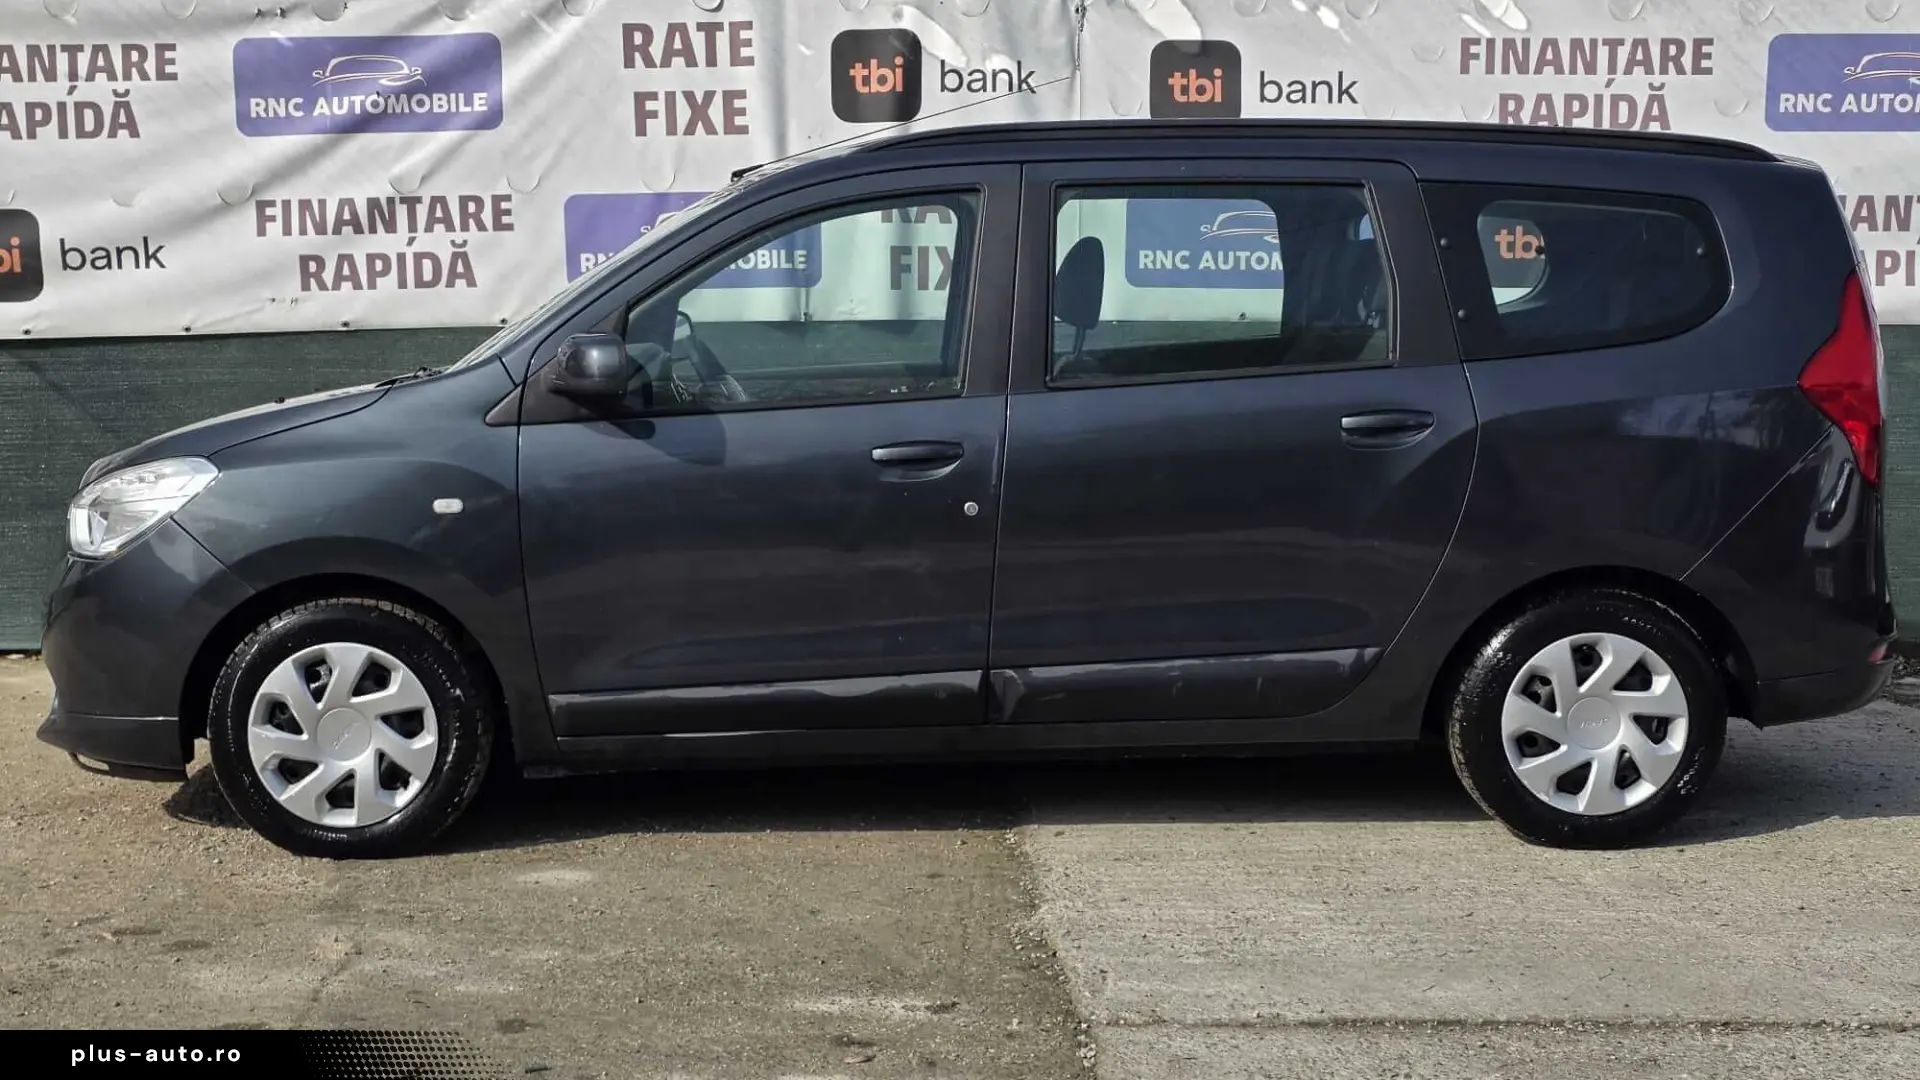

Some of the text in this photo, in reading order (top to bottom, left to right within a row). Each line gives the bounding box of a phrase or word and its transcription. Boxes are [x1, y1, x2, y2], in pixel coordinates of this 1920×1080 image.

[622, 21, 755, 69] RATE
[849, 56, 1038, 94] tbi bank
[1168, 68, 1359, 104] tbi bank
[250, 92, 488, 119] RNC AUTOMOBILE
[633, 89, 750, 137] FIXE
[1779, 92, 1920, 113] RNC AUTO
[59, 236, 167, 271] bank
[728, 249, 807, 270] OBILE
[1138, 250, 1191, 270] RNC
